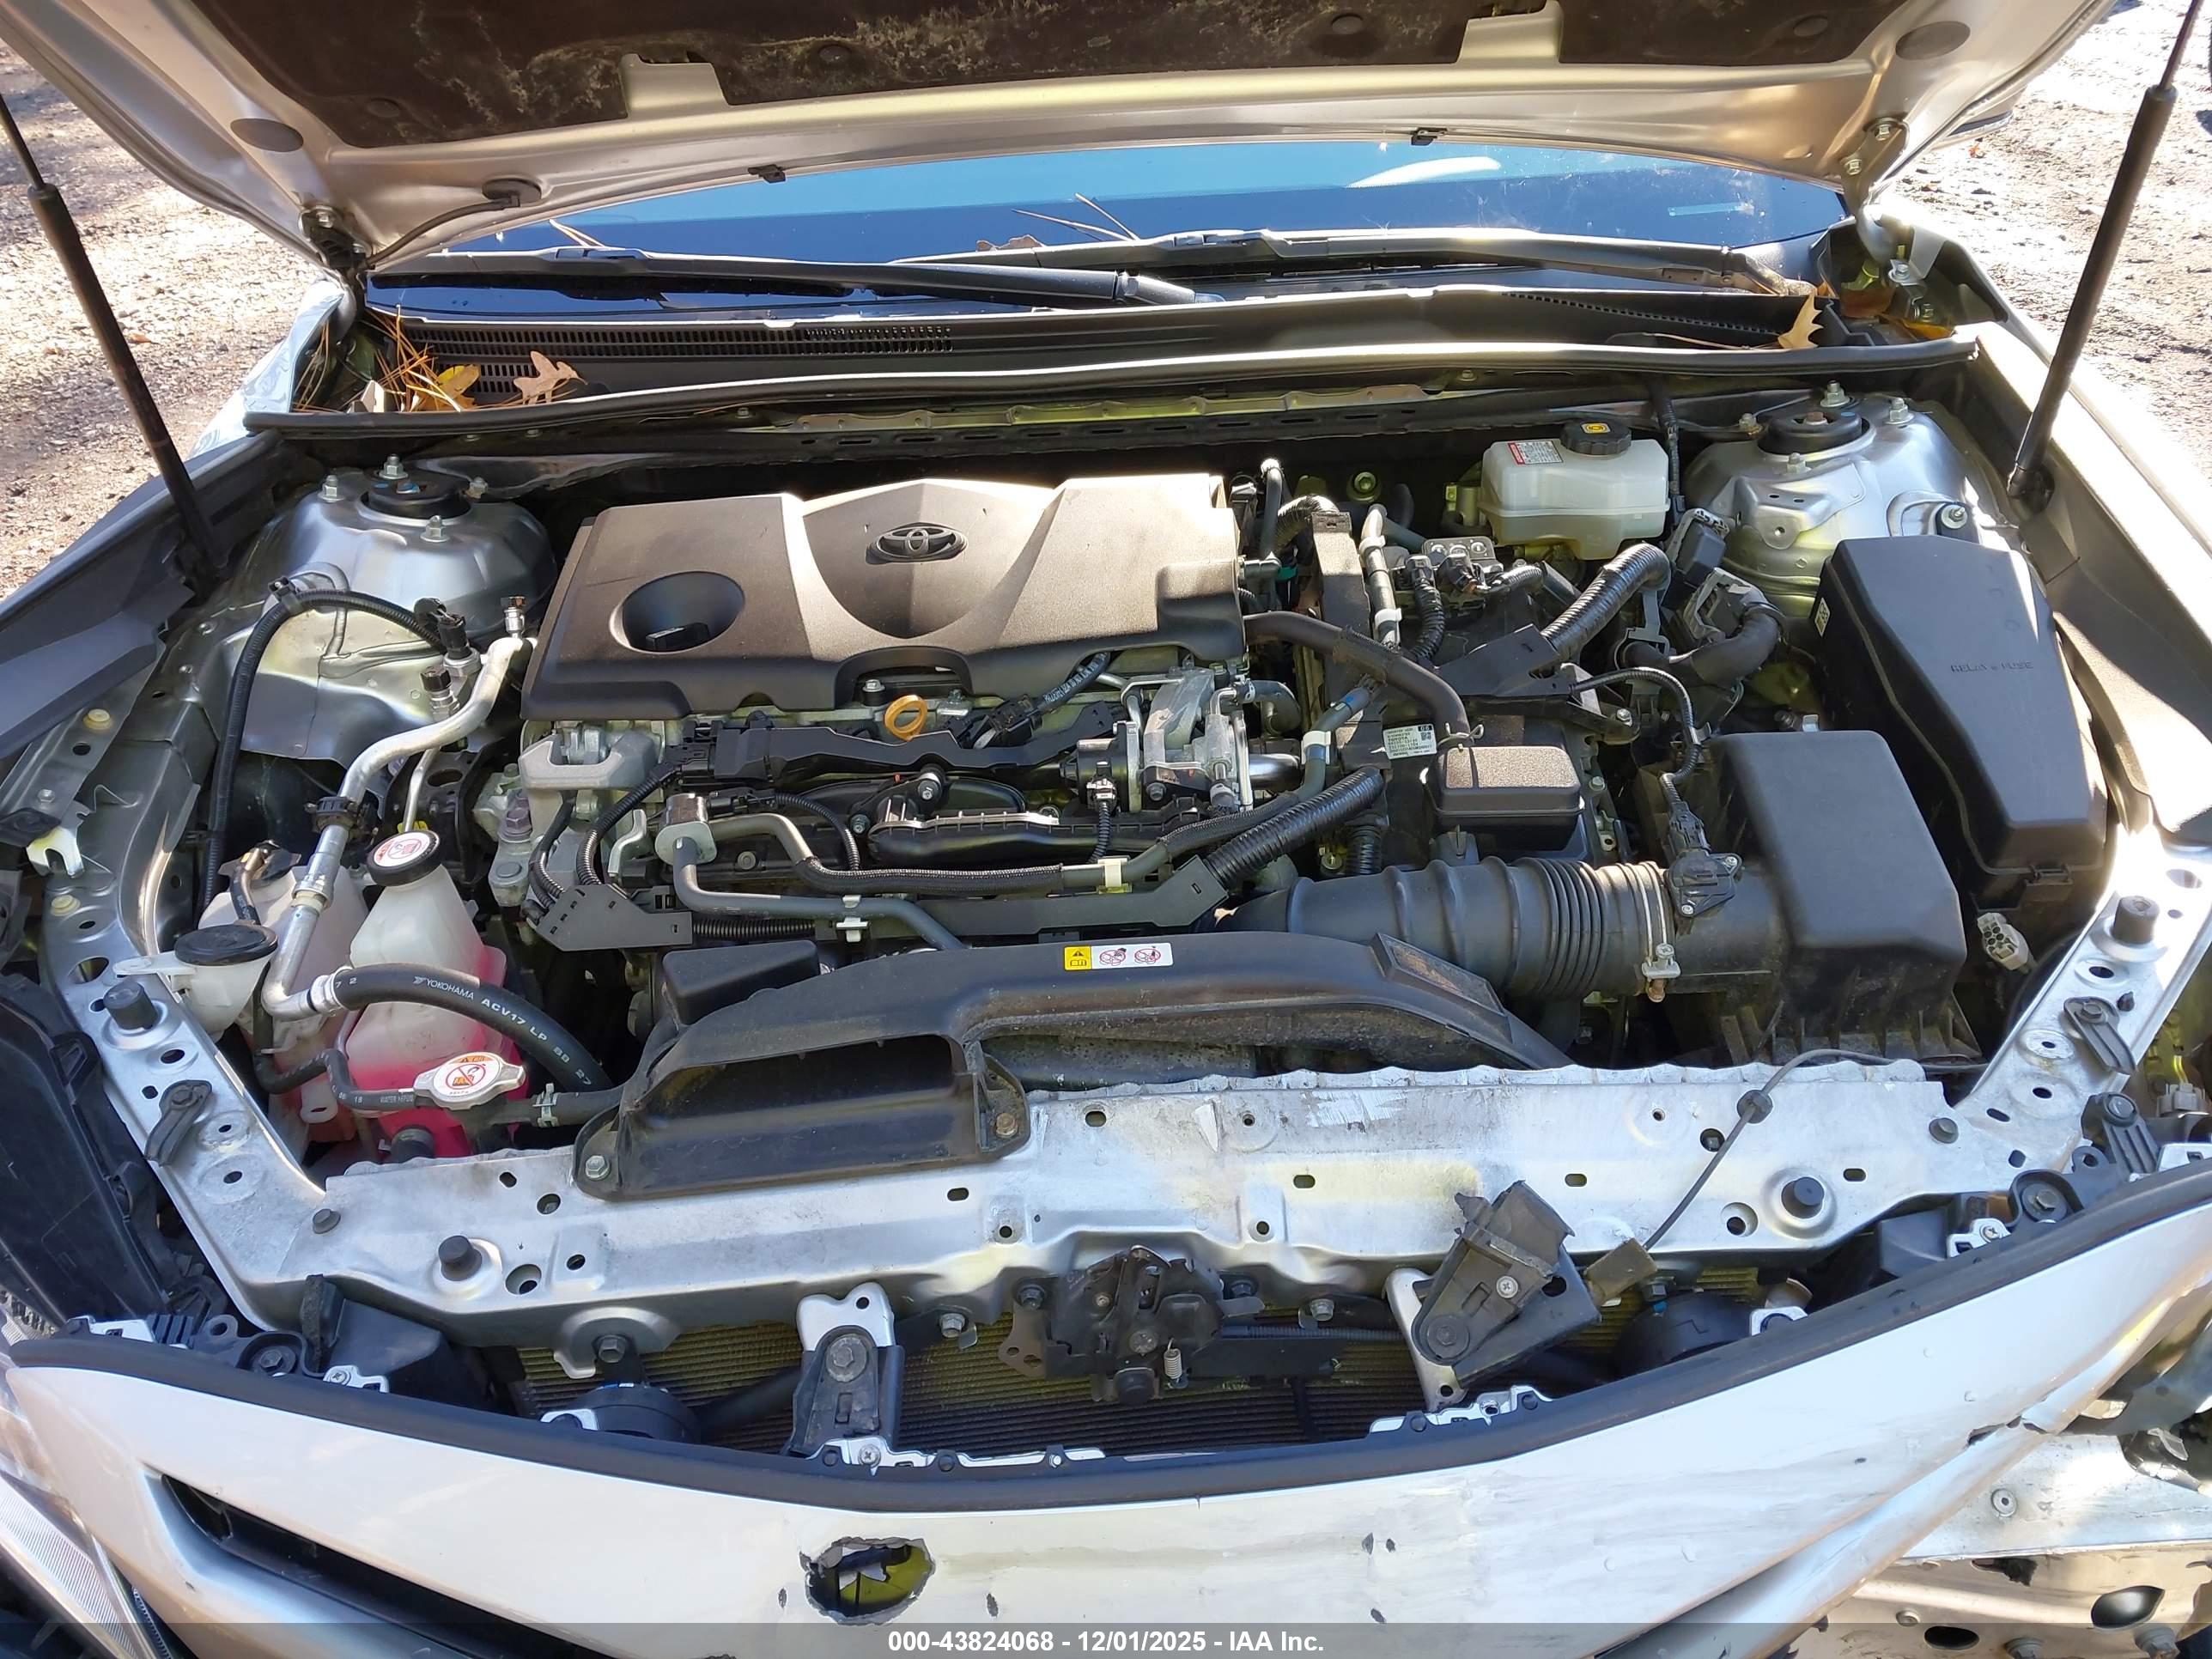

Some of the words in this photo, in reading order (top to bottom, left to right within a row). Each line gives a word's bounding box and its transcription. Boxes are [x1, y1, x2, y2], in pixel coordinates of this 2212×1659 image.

[349, 976, 358, 985] 2
[426, 978, 474, 1001] YOKOHAMA
[481, 998, 526, 1024] ACV17
[530, 1026, 547, 1041] LP
[575, 1068, 592, 1085] 27
